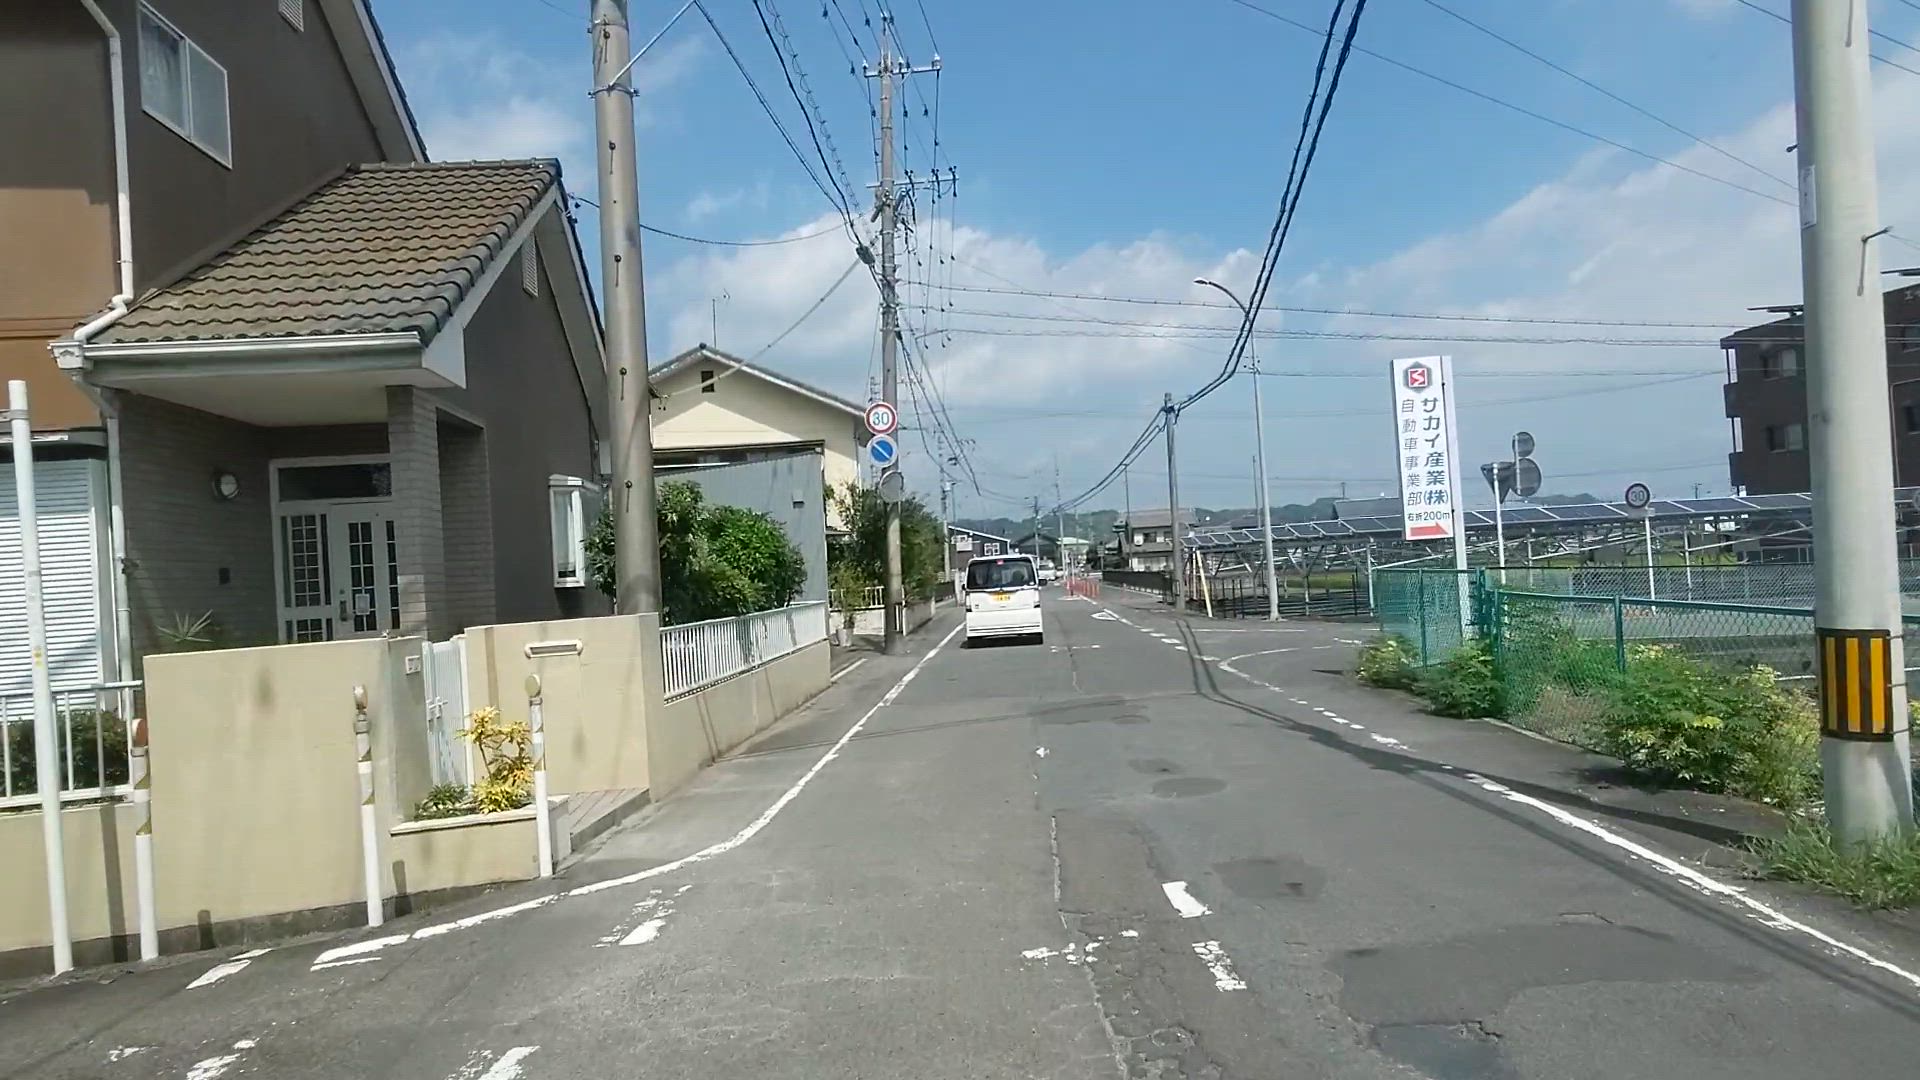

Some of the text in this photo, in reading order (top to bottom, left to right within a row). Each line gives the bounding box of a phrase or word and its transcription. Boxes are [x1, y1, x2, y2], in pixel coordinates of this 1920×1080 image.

[872, 411, 889, 426] 30
[1402, 398, 1422, 506] 自動車事業部
[1421, 397, 1449, 506] サカイ産業(株)
[1631, 490, 1645, 502] 30
[1407, 511, 1450, 521] 右折200m
